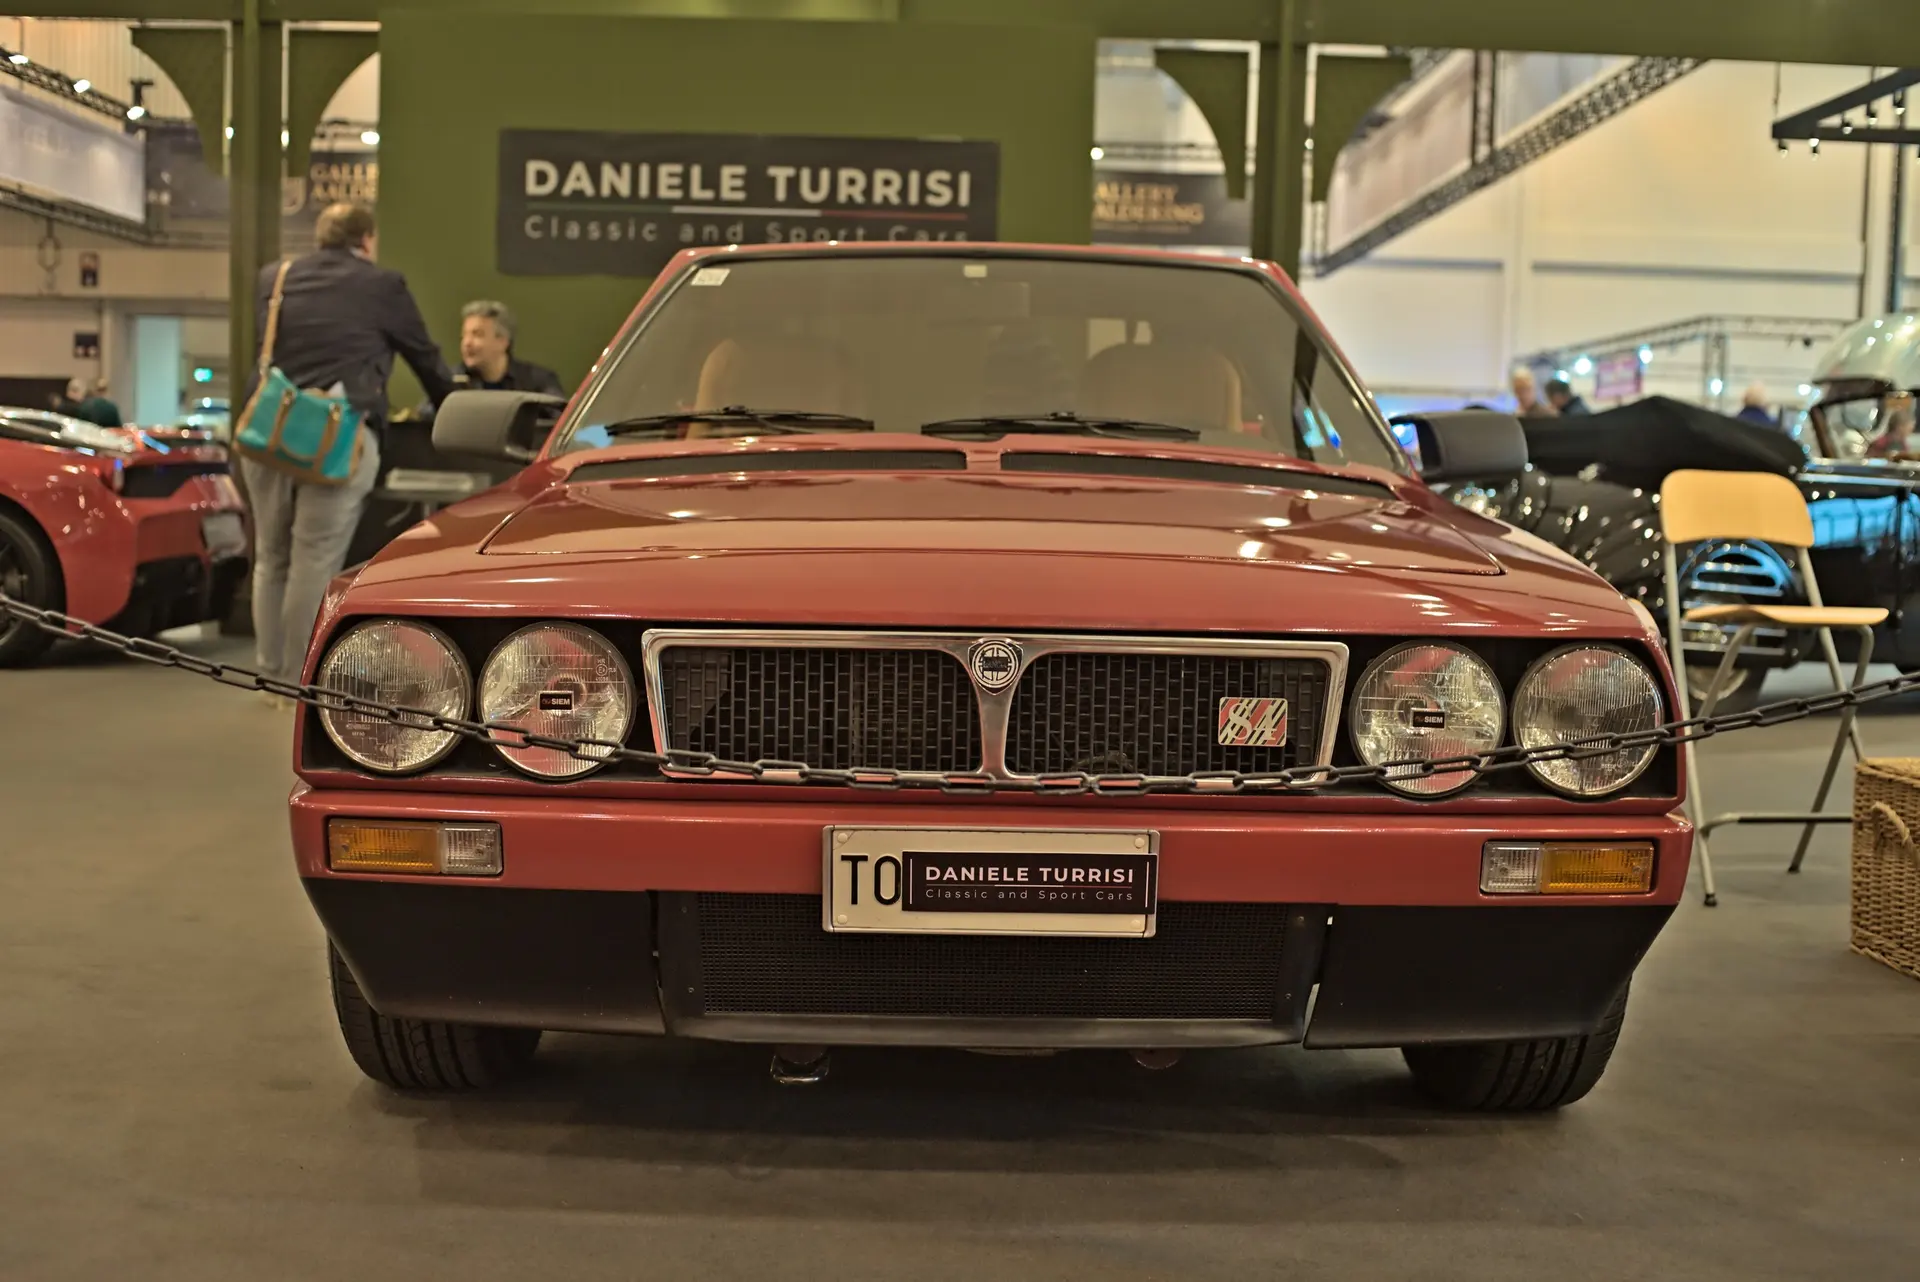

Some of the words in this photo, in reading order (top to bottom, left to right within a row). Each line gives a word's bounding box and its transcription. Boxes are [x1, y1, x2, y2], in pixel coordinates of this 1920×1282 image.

[525, 159, 747, 200] DANIELE
[767, 165, 971, 208] TURRISI
[525, 215, 657, 241] Classic
[679, 220, 744, 242] and
[765, 221, 867, 243] Sport
[1424, 716, 1443, 724] SIEM
[841, 854, 902, 906] TO
[925, 866, 1029, 882] DANIELE
[1039, 867, 1133, 883] TURRISI
[925, 888, 988, 899] Classic
[998, 890, 1028, 900] and
[1038, 890, 1086, 901] Sport
[1095, 891, 1133, 901] Cars
